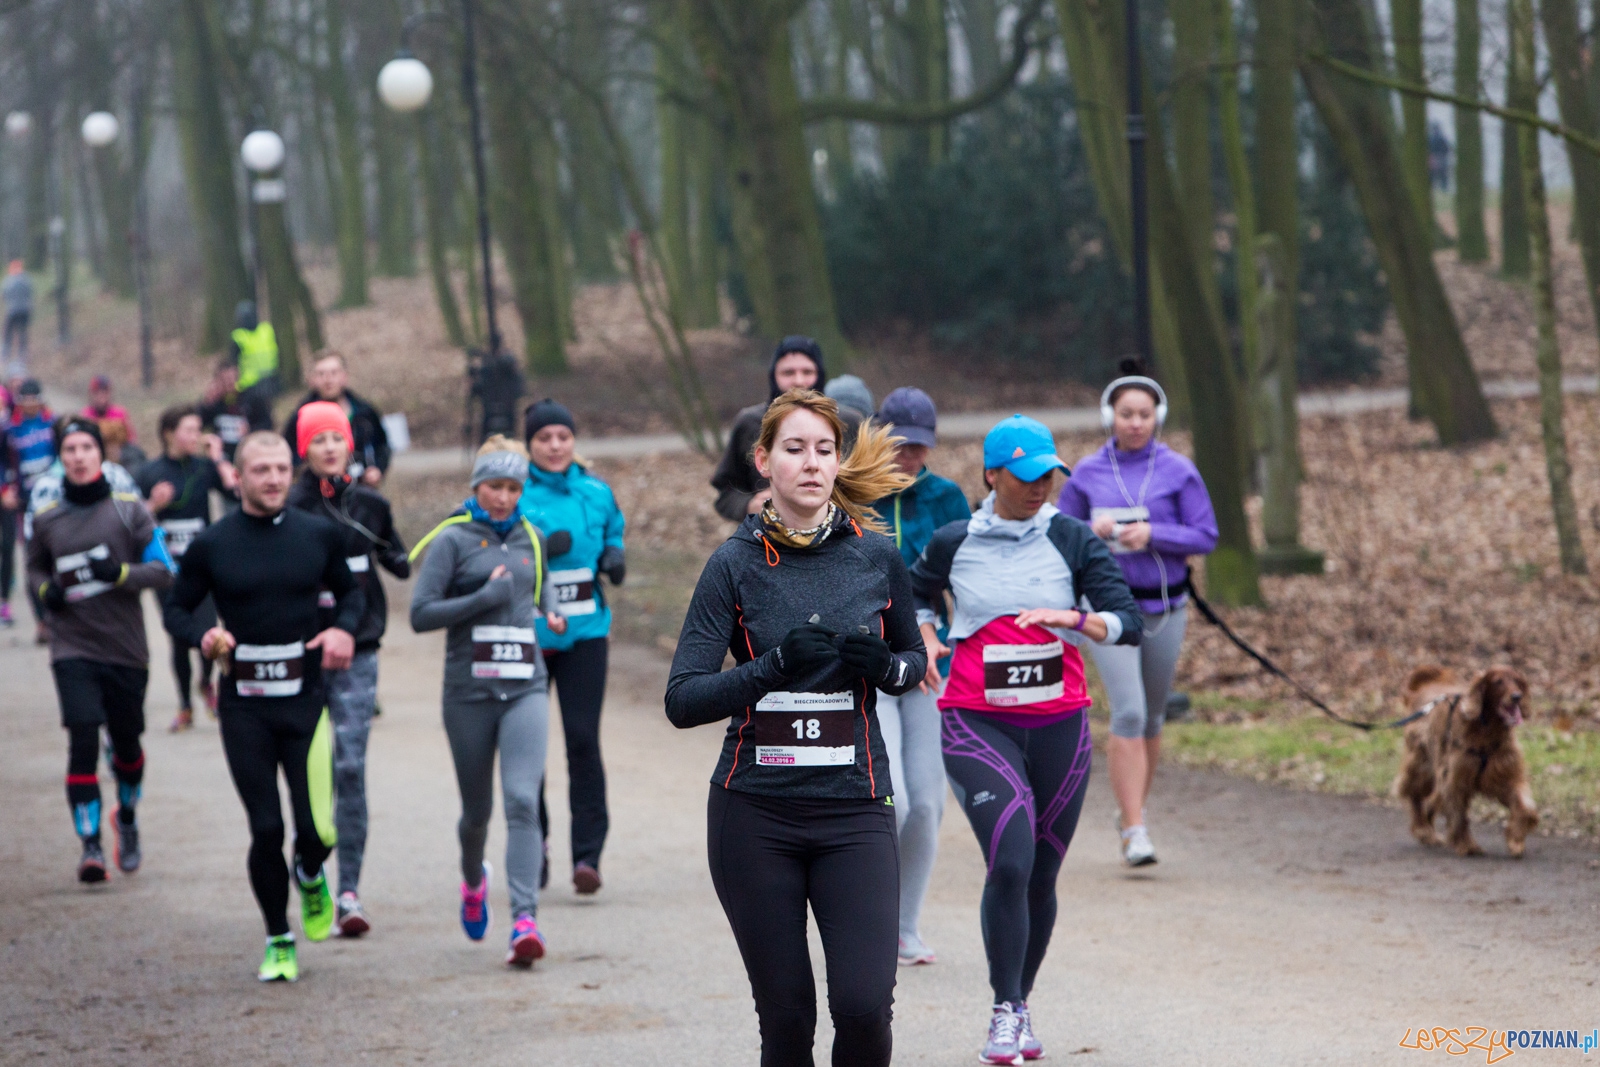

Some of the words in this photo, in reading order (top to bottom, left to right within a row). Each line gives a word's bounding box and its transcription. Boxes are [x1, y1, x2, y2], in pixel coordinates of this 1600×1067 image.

[491, 643, 523, 661] 323
[254, 662, 288, 679] 316
[1007, 664, 1044, 684] 271
[791, 719, 821, 739] 18
